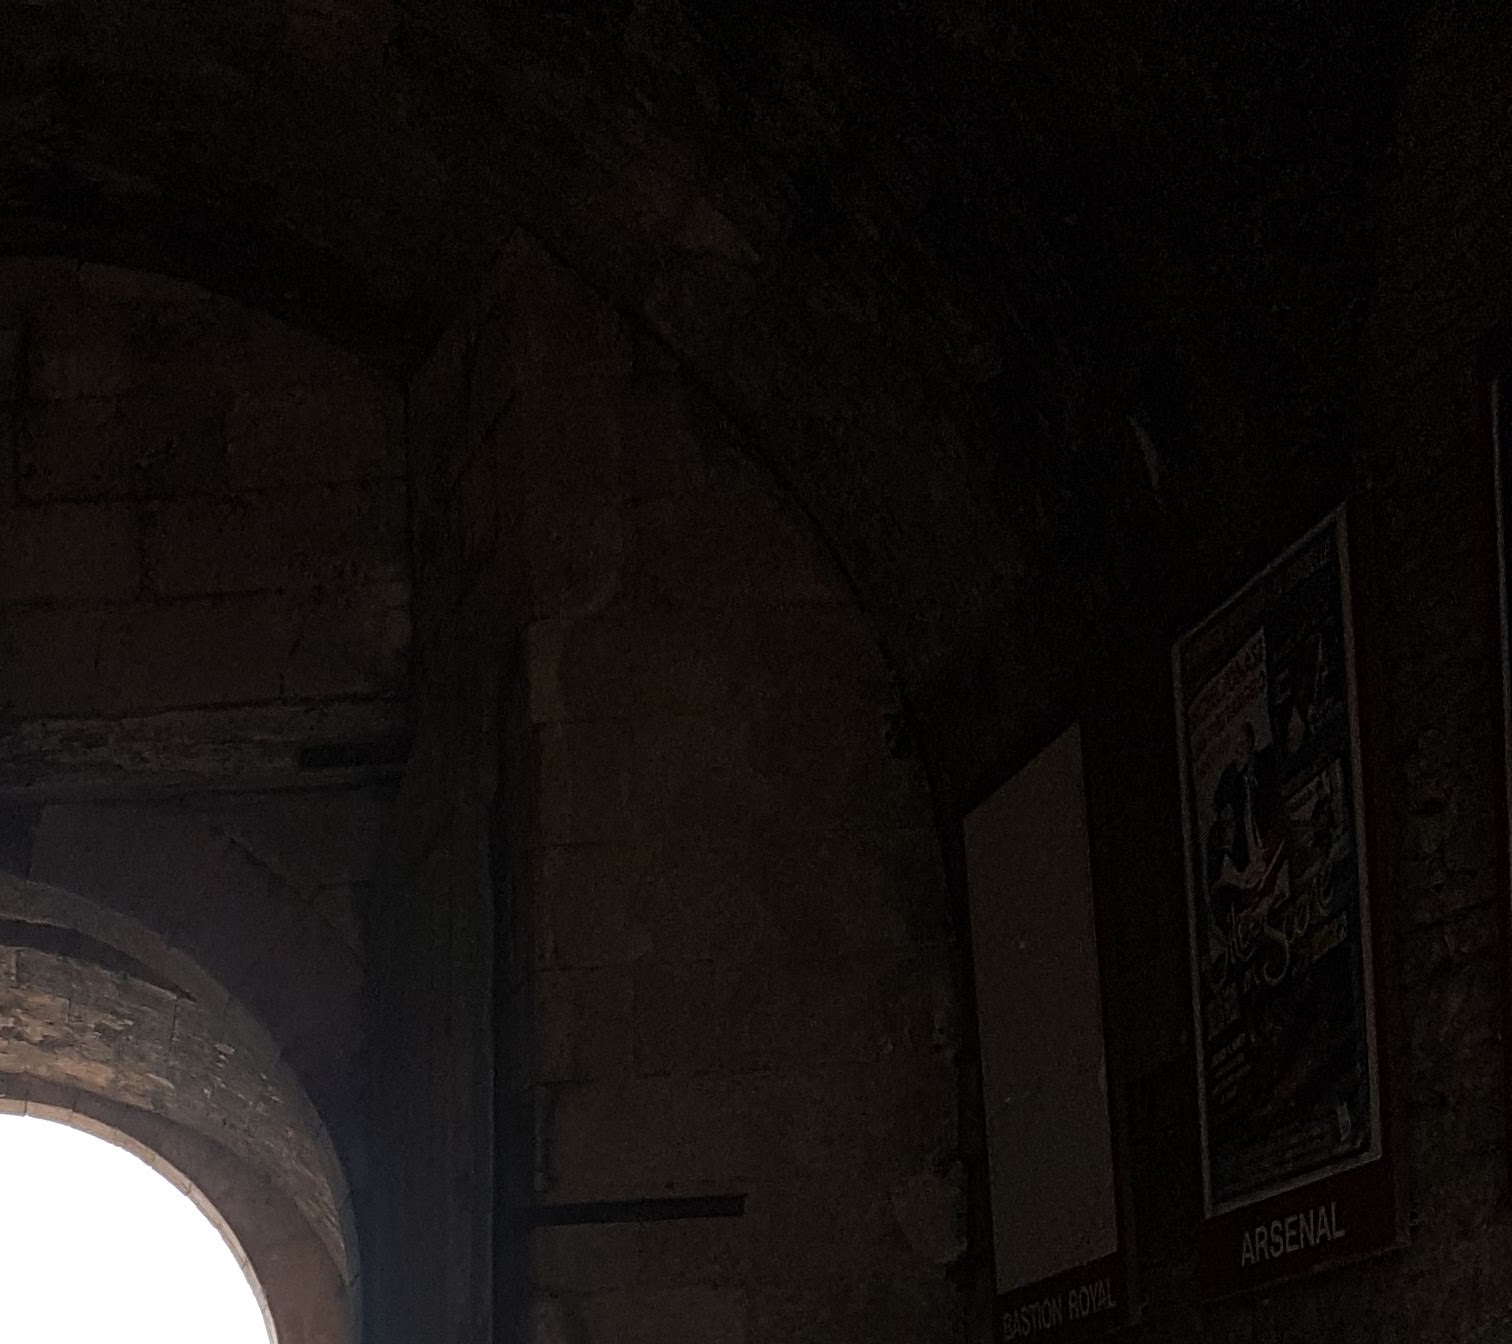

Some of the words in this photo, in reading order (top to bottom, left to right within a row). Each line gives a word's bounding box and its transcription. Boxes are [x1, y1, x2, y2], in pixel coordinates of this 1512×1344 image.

[1241, 1201, 1346, 1268] ARSENAL
[1001, 1294, 1064, 1344] BASTION
[1067, 1278, 1117, 1321] ROYAL
